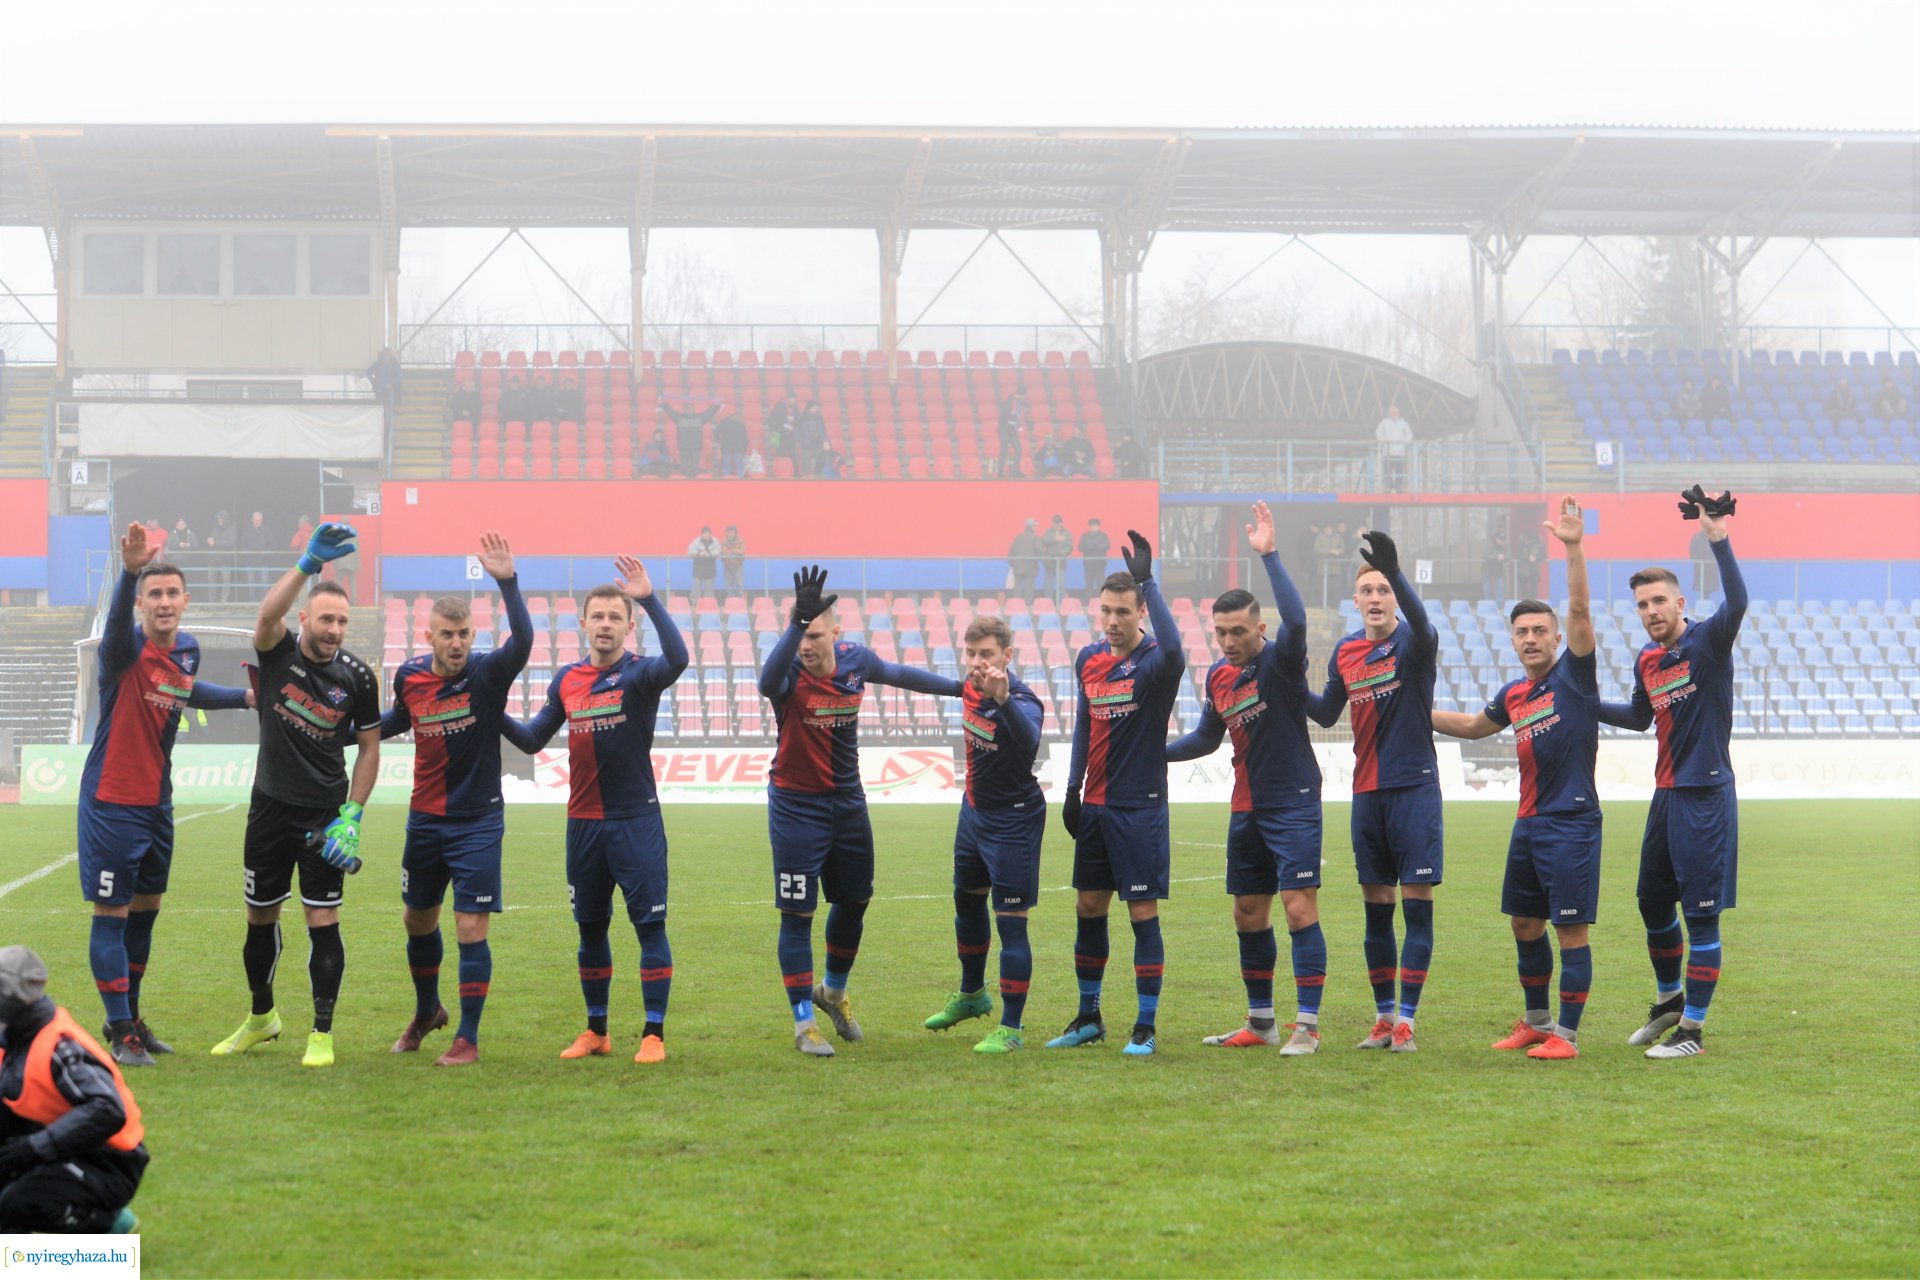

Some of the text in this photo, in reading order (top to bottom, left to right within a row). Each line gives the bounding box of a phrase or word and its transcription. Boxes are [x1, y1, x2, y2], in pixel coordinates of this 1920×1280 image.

[75, 470, 84, 482] A
[371, 502, 380, 514] B
[470, 565, 479, 577] C
[1419, 569, 1428, 581] D
[650, 753, 770, 782] REVE
[1296, 871, 1313, 879] JAKO
[1416, 867, 1433, 875] JAKO
[98, 870, 114, 898] 5
[779, 872, 806, 900] 23
[1130, 884, 1148, 892] JAKO
[475, 895, 493, 903] JAKO
[651, 903, 666, 913] JAKO
[1560, 908, 1577, 916] JAKO
